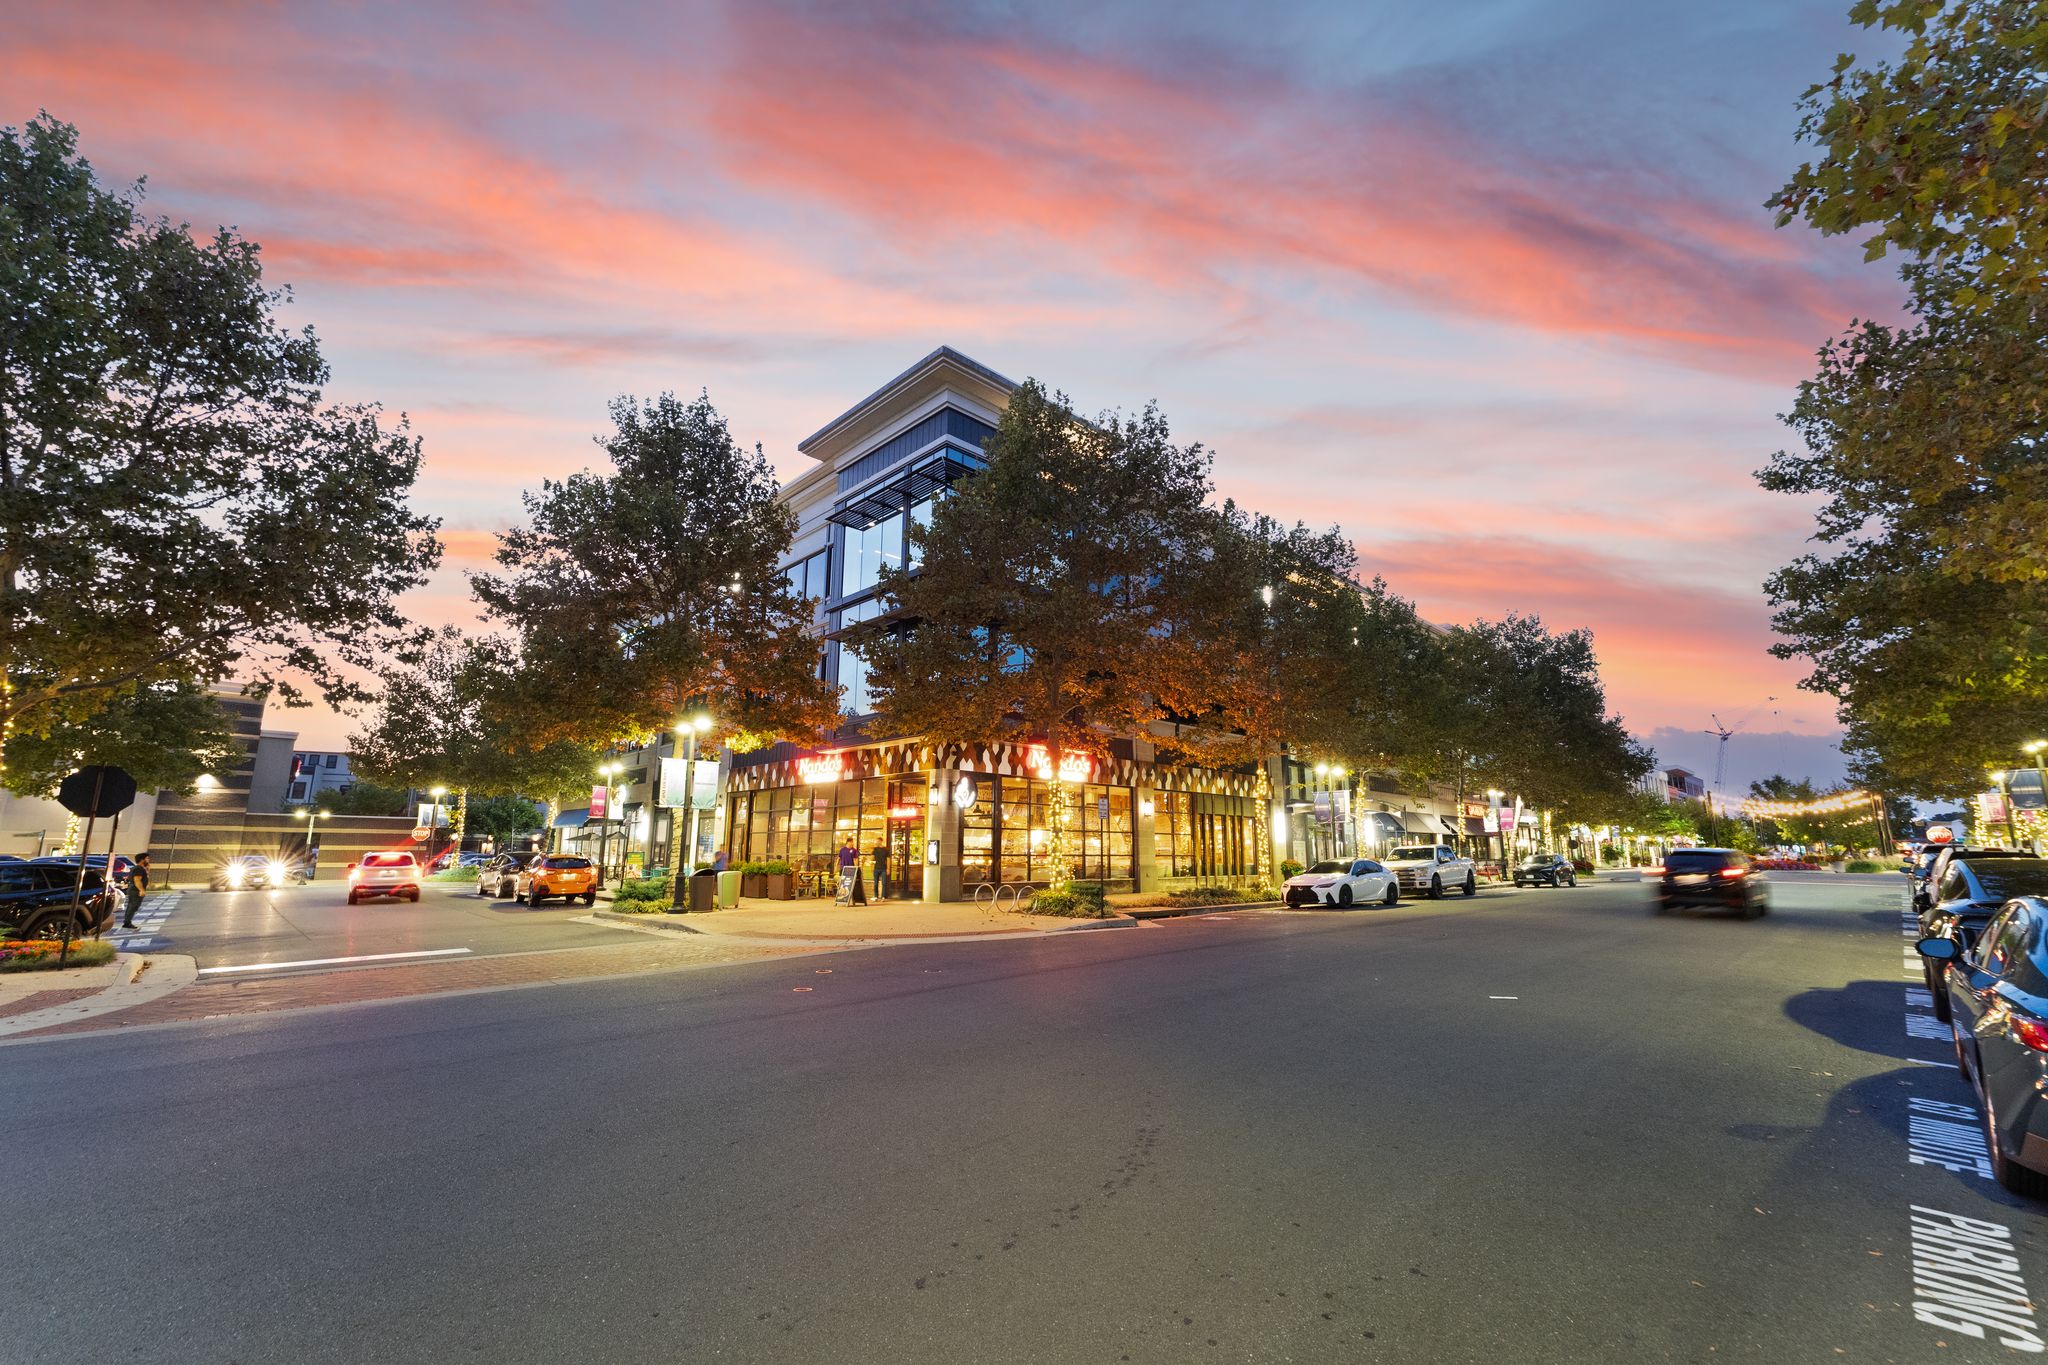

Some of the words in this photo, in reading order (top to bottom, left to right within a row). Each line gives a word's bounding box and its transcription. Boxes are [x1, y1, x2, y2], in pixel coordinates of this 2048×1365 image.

[798, 754, 842, 774] Nando's
[1030, 750, 1090, 773] Nado's
[1929, 831, 1950, 839] STOP
[1909, 1097, 1977, 1120] 60
[1908, 1115, 1995, 1180] MINUTE
[1910, 1204, 2046, 1353] PARKING
